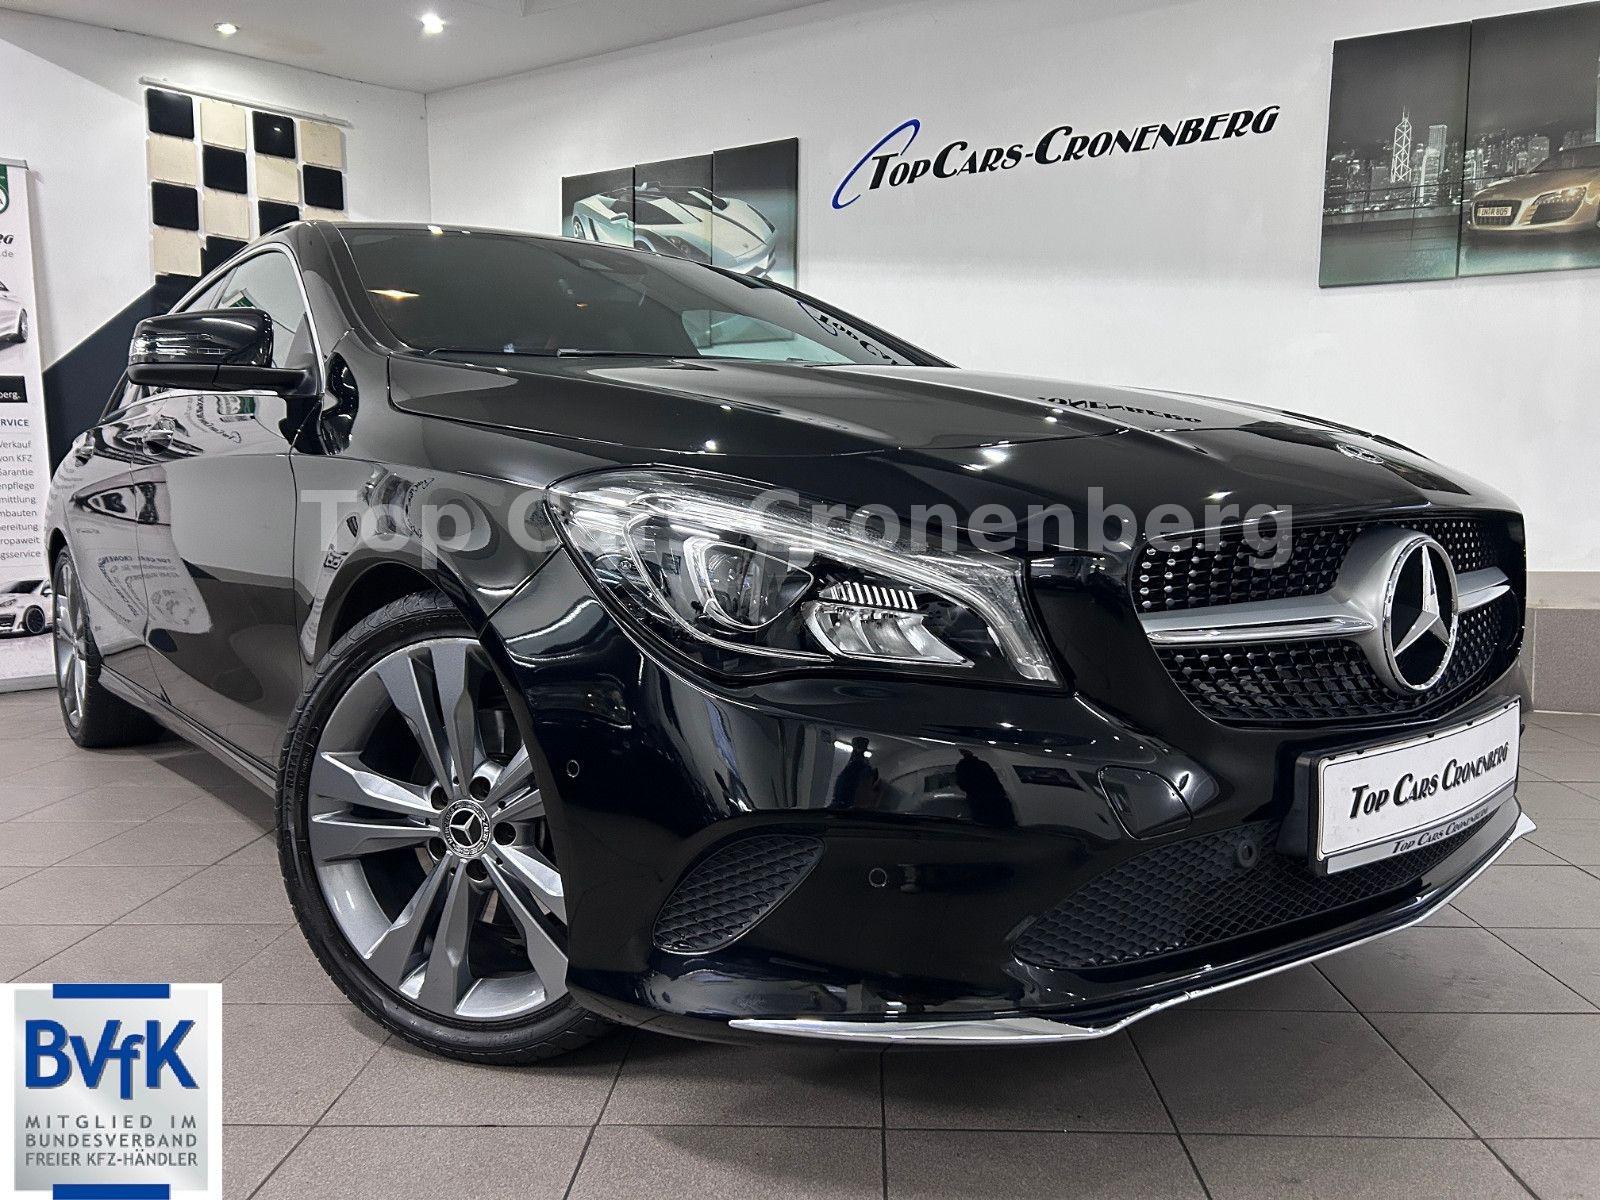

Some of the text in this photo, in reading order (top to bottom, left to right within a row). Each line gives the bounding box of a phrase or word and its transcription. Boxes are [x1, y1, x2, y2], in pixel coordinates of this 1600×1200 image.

[16, 454, 33, 462] KFZ
[1350, 784, 1389, 819] TOP
[1393, 773, 1438, 806] CARS
